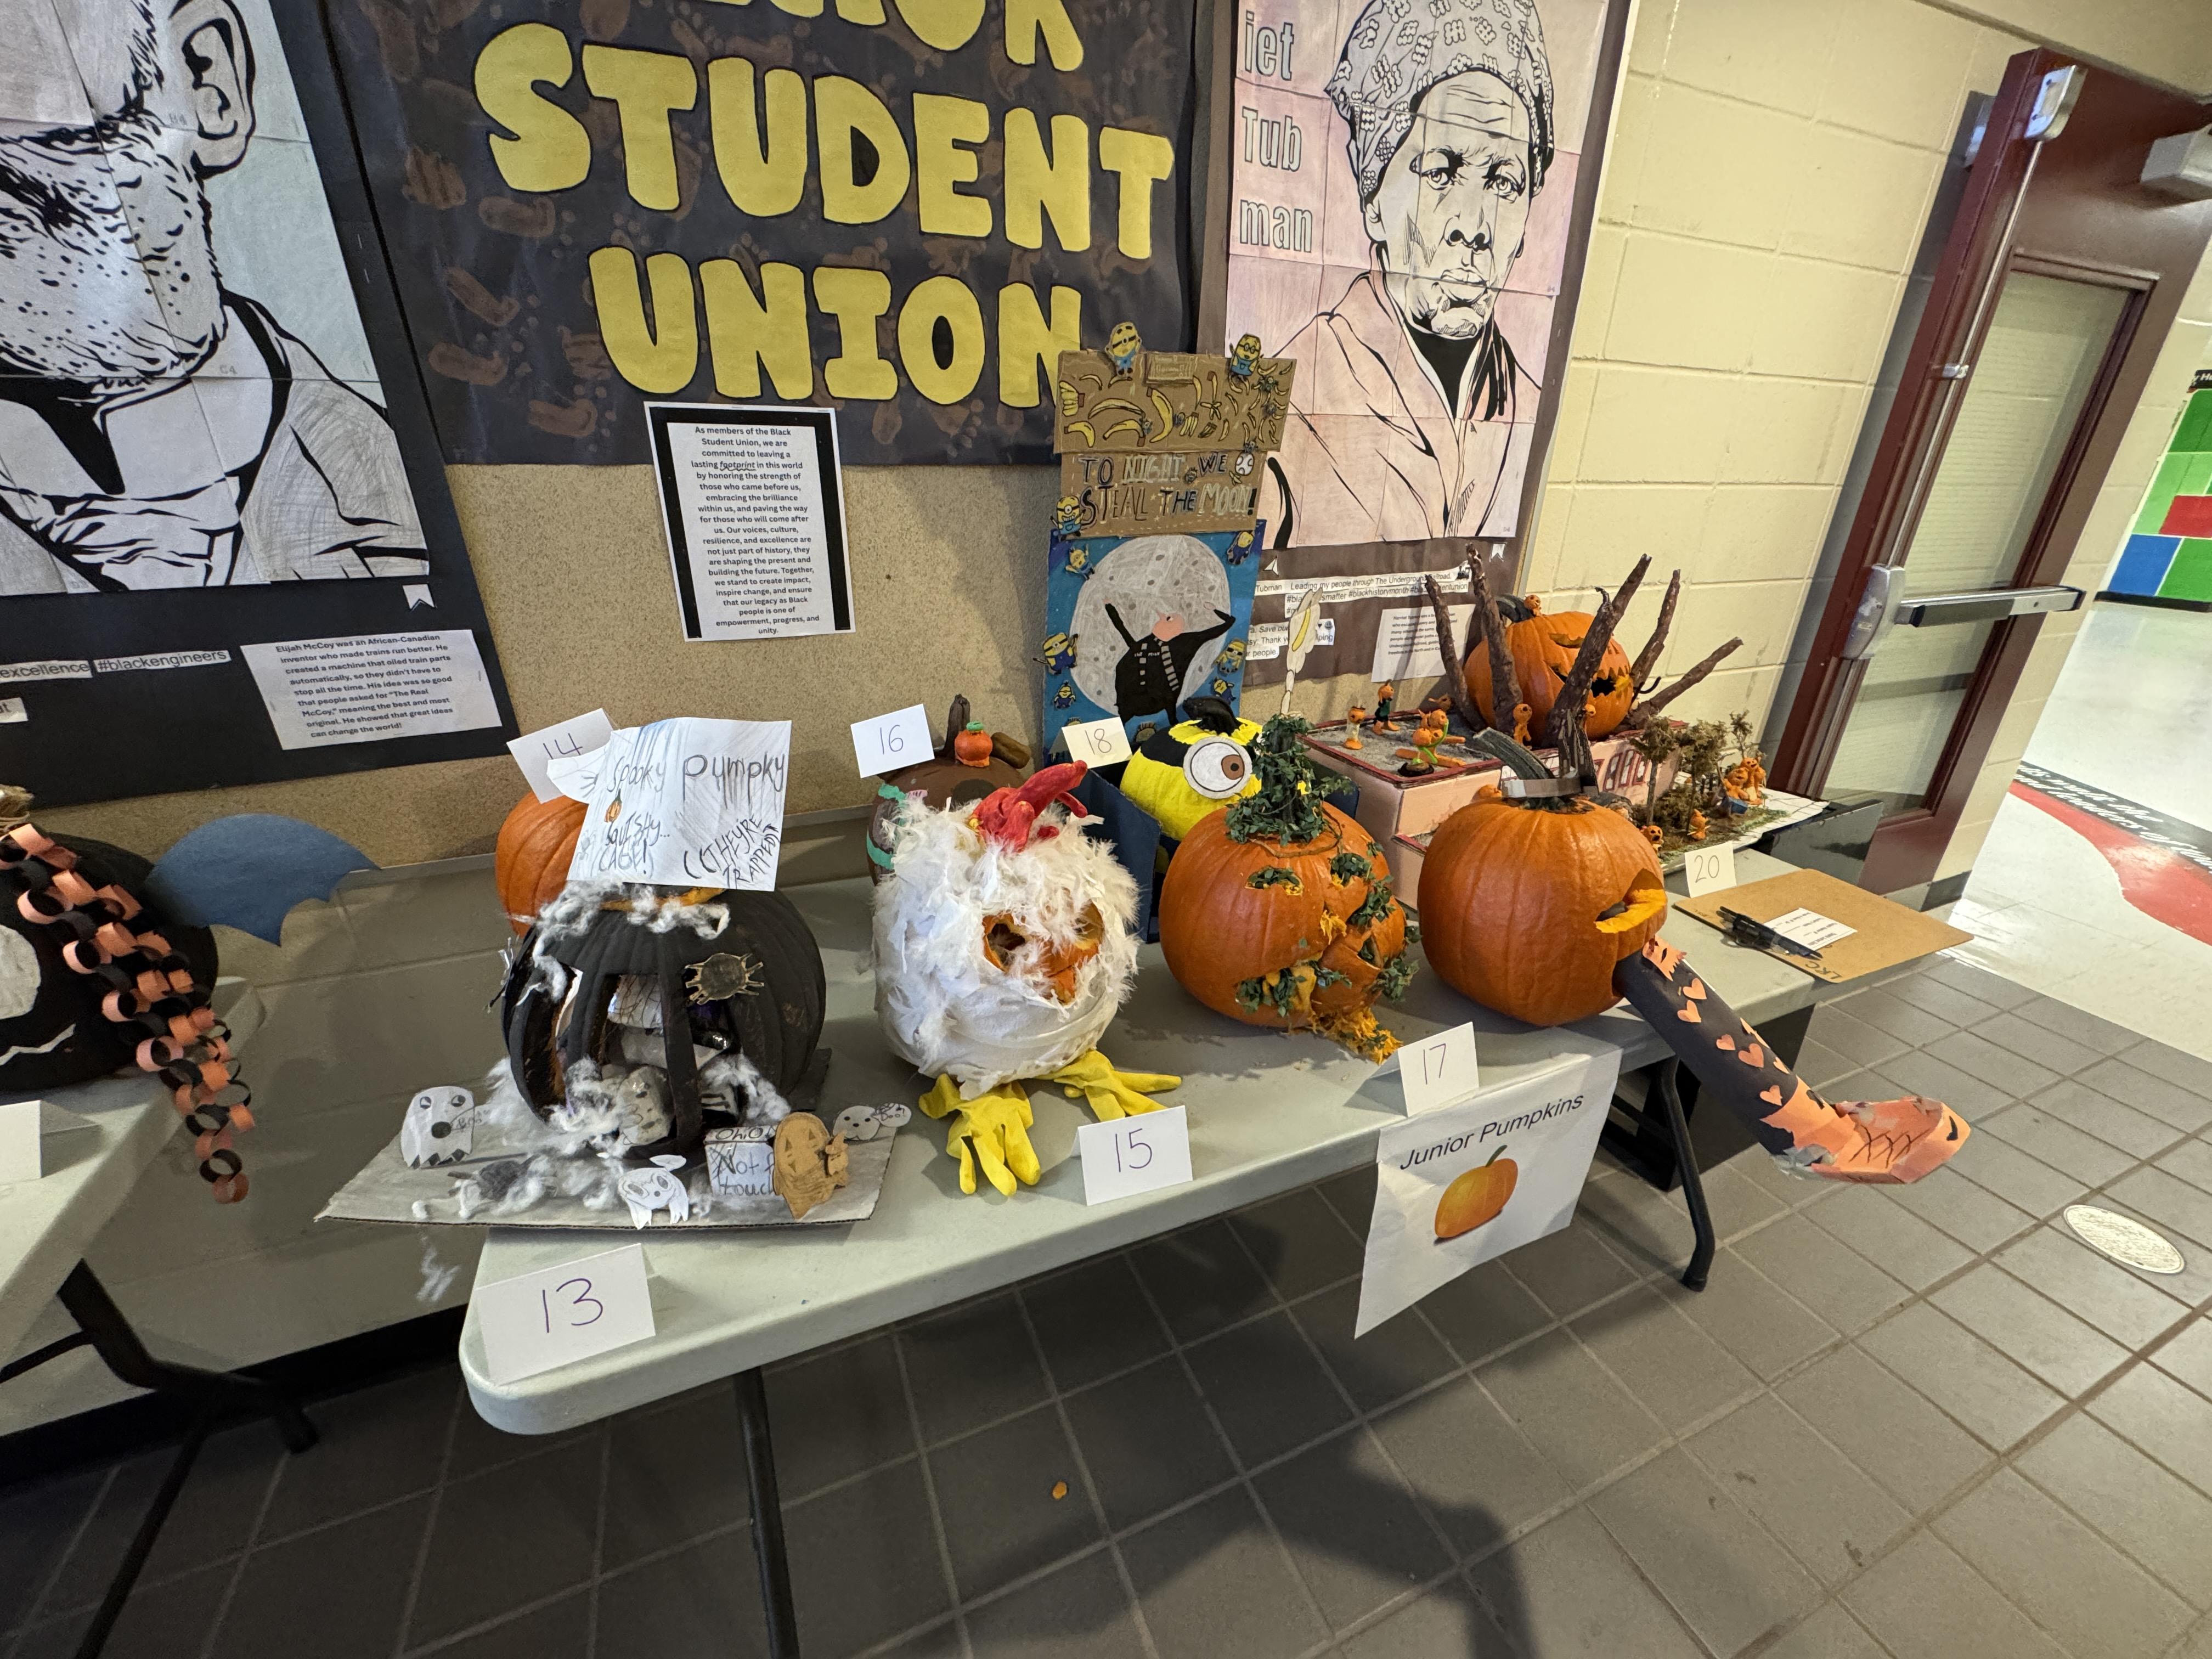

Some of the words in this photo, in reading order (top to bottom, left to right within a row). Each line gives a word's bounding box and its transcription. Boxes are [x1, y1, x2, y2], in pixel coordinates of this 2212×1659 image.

[1245, 10, 1294, 81] iet
[473, 22, 1174, 259] STUDENT
[1242, 106, 1302, 172] Tub
[1240, 199, 1313, 253] man
[588, 246, 1081, 408] UNION
[735, 438, 761, 448] Union,
[757, 450, 785, 460] leaving
[691, 460, 719, 470] lasting
[719, 461, 757, 470] footprint
[696, 471, 706, 481] by
[708, 472, 744, 481] honoring
[759, 472, 792, 481] strength
[1198, 452, 1228, 477] WE
[706, 494, 747, 503] embracing
[753, 505, 778, 514] paving
[1079, 485, 1149, 527] STEAL
[1159, 488, 1198, 516] THE
[1197, 483, 1257, 517] MOON!
[742, 526, 769, 534] voices,
[770, 526, 799, 534] culture,
[1256, 584, 1282, 592] Tubman
[1290, 582, 1318, 591] Leading
[1331, 579, 1351, 589] people
[1353, 578, 1374, 586] through
[1348, 586, 1409, 597] #blackhistorymonth
[275, 645, 302, 653] Elijah
[302, 642, 334, 650] McCoy
[368, 635, 441, 645] African-Canadian
[1262, 636, 1283, 644] Thank
[98, 651, 227, 671] #blackengineers
[285, 665, 320, 674] created
[328, 662, 366, 670] machine
[429, 655, 452, 663] parts
[289, 674, 353, 685] automatically,
[432, 676, 453, 685] good
[543, 733, 583, 760] 14
[879, 724, 904, 755] 16
[1085, 727, 1112, 755] 18
[2047, 791, 2149, 830] leaders
[1694, 854, 1720, 883] 20
[1423, 1043, 1446, 1085] 17
[1400, 1132, 1474, 1170] Junior
[1479, 1094, 1584, 1143] Pumpkins
[1115, 1128, 1153, 1172] 15
[543, 1278, 603, 1333] 13
